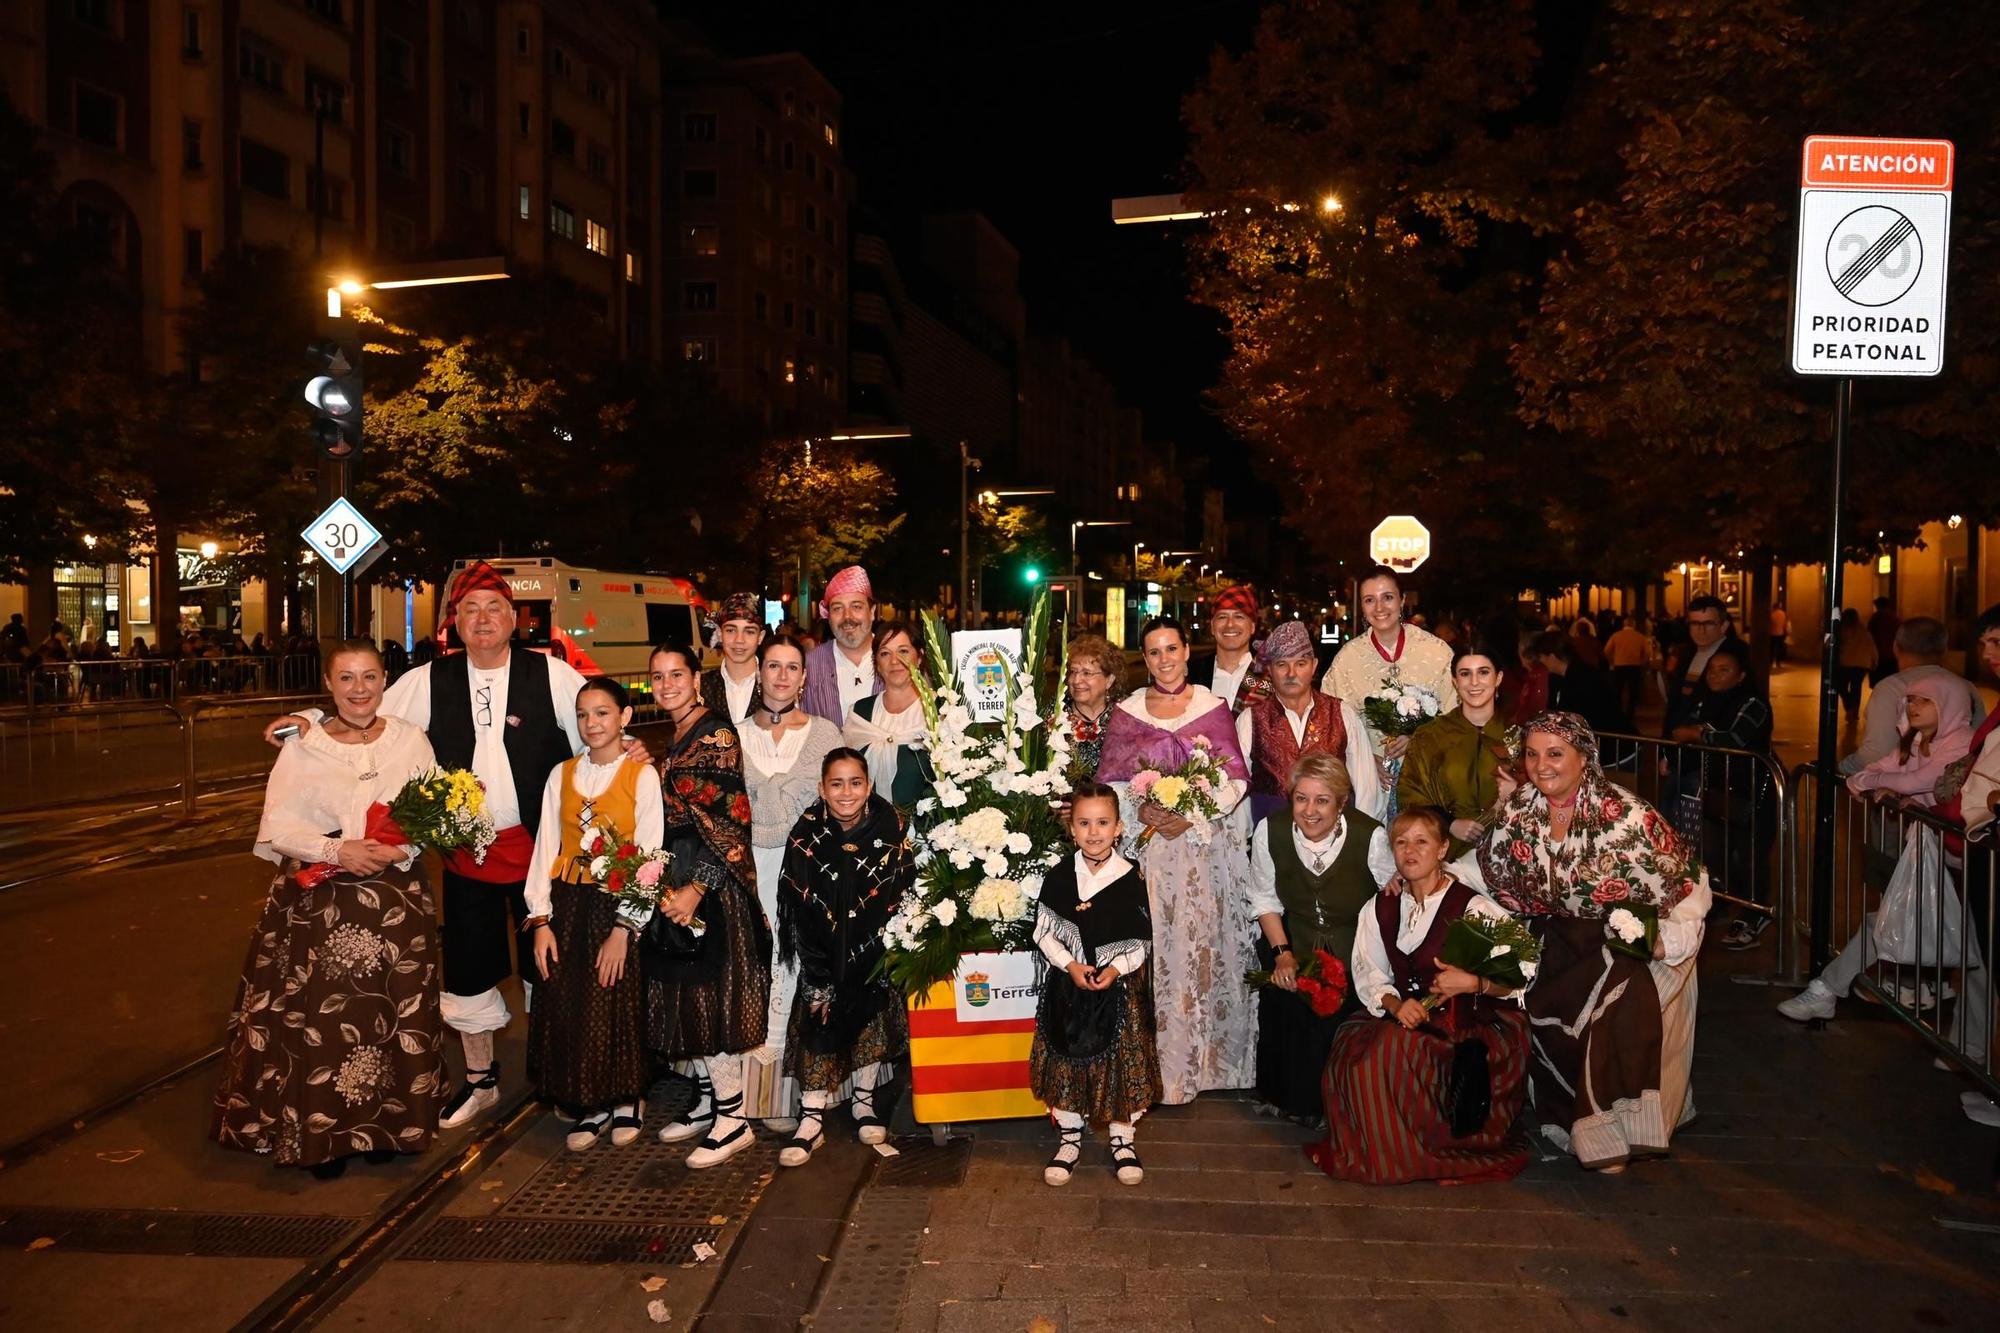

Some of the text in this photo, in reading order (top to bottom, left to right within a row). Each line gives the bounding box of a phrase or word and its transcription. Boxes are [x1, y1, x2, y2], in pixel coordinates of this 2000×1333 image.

[1820, 154, 1936, 174] ATENCIÓN
[1837, 232, 1912, 280] 20
[1812, 315, 1930, 334] PRIORIDAD
[1812, 343, 1927, 361] PEATONAL
[324, 523, 359, 548] 30
[1377, 537, 1425, 552] STOP
[968, 642, 988, 655] MUNICIPAL
[978, 701, 1004, 710] TERRER
